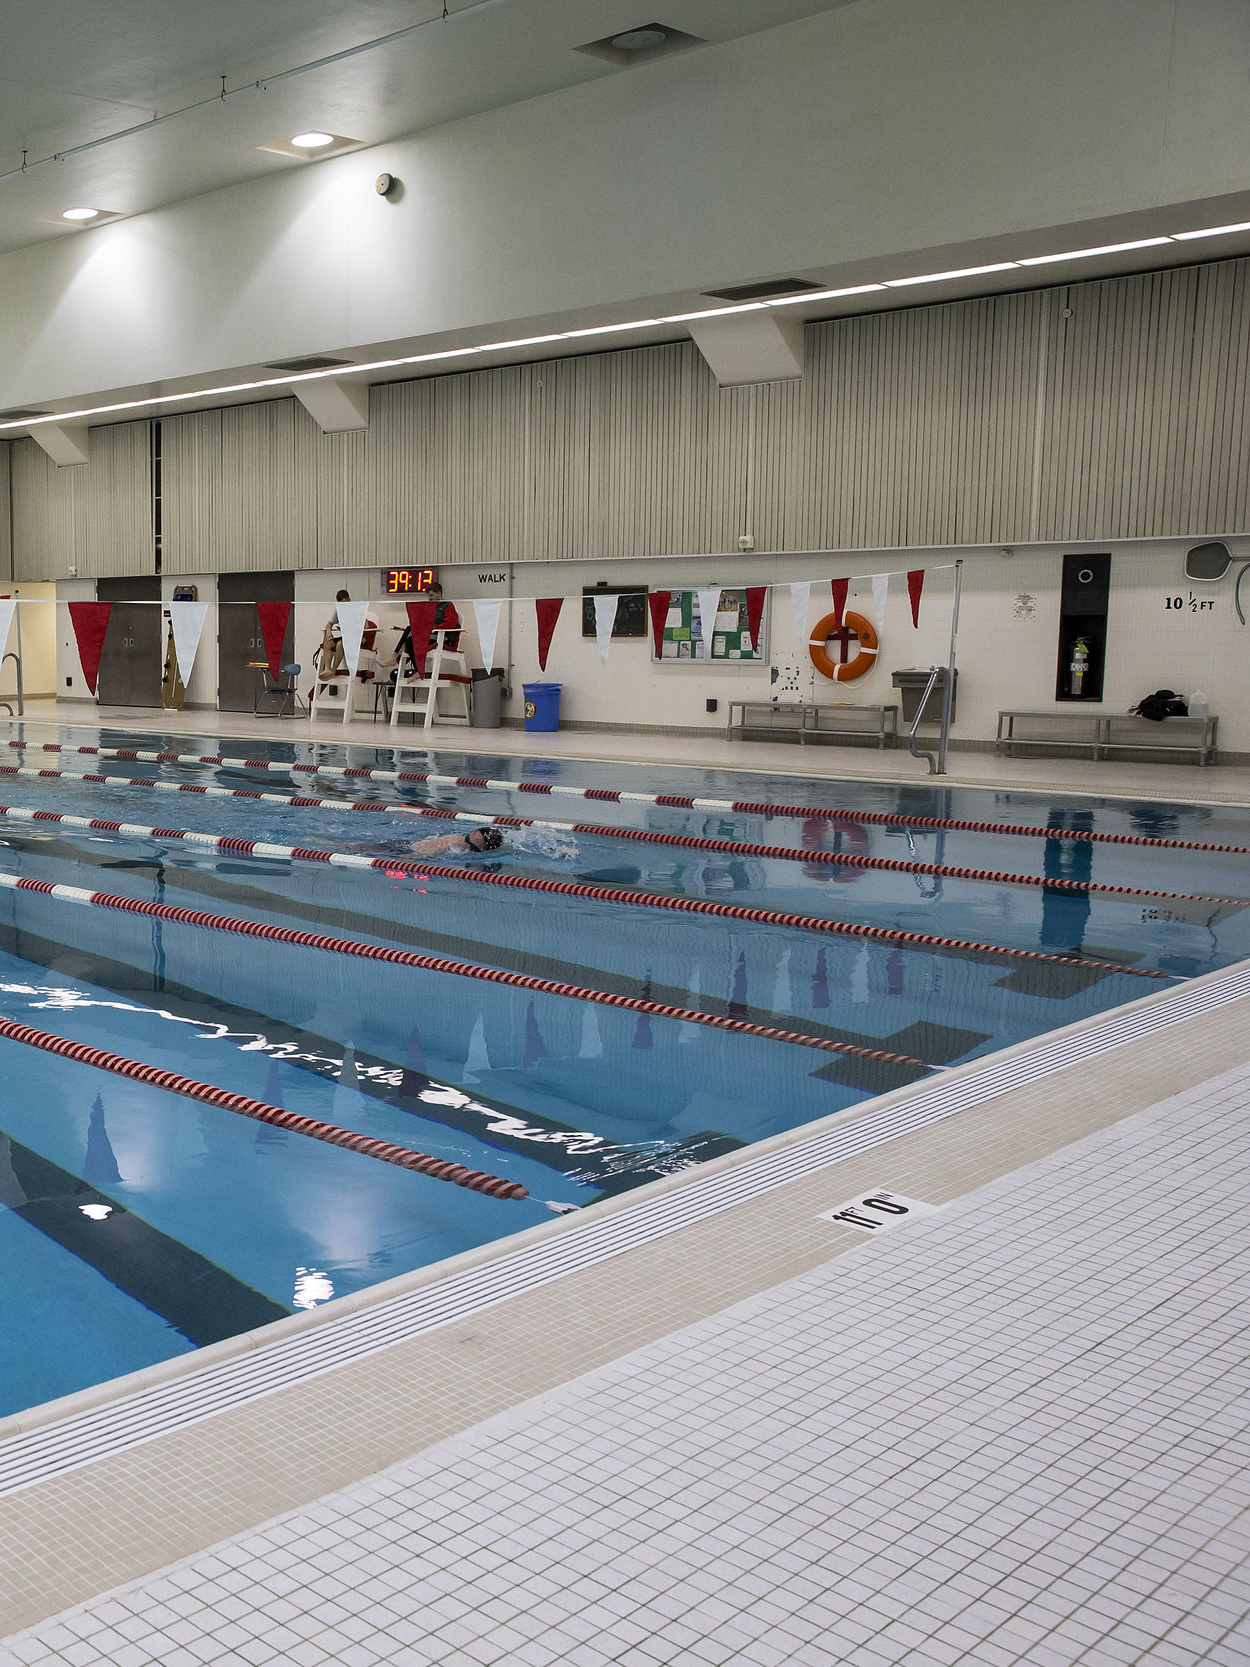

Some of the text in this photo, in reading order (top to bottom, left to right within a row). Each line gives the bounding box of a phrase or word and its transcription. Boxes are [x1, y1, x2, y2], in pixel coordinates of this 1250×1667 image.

[478, 573, 507, 583] WALK
[1165, 597, 1183, 610] 10
[1200, 601, 1215, 610] FT
[831, 1211, 884, 1230] 11
